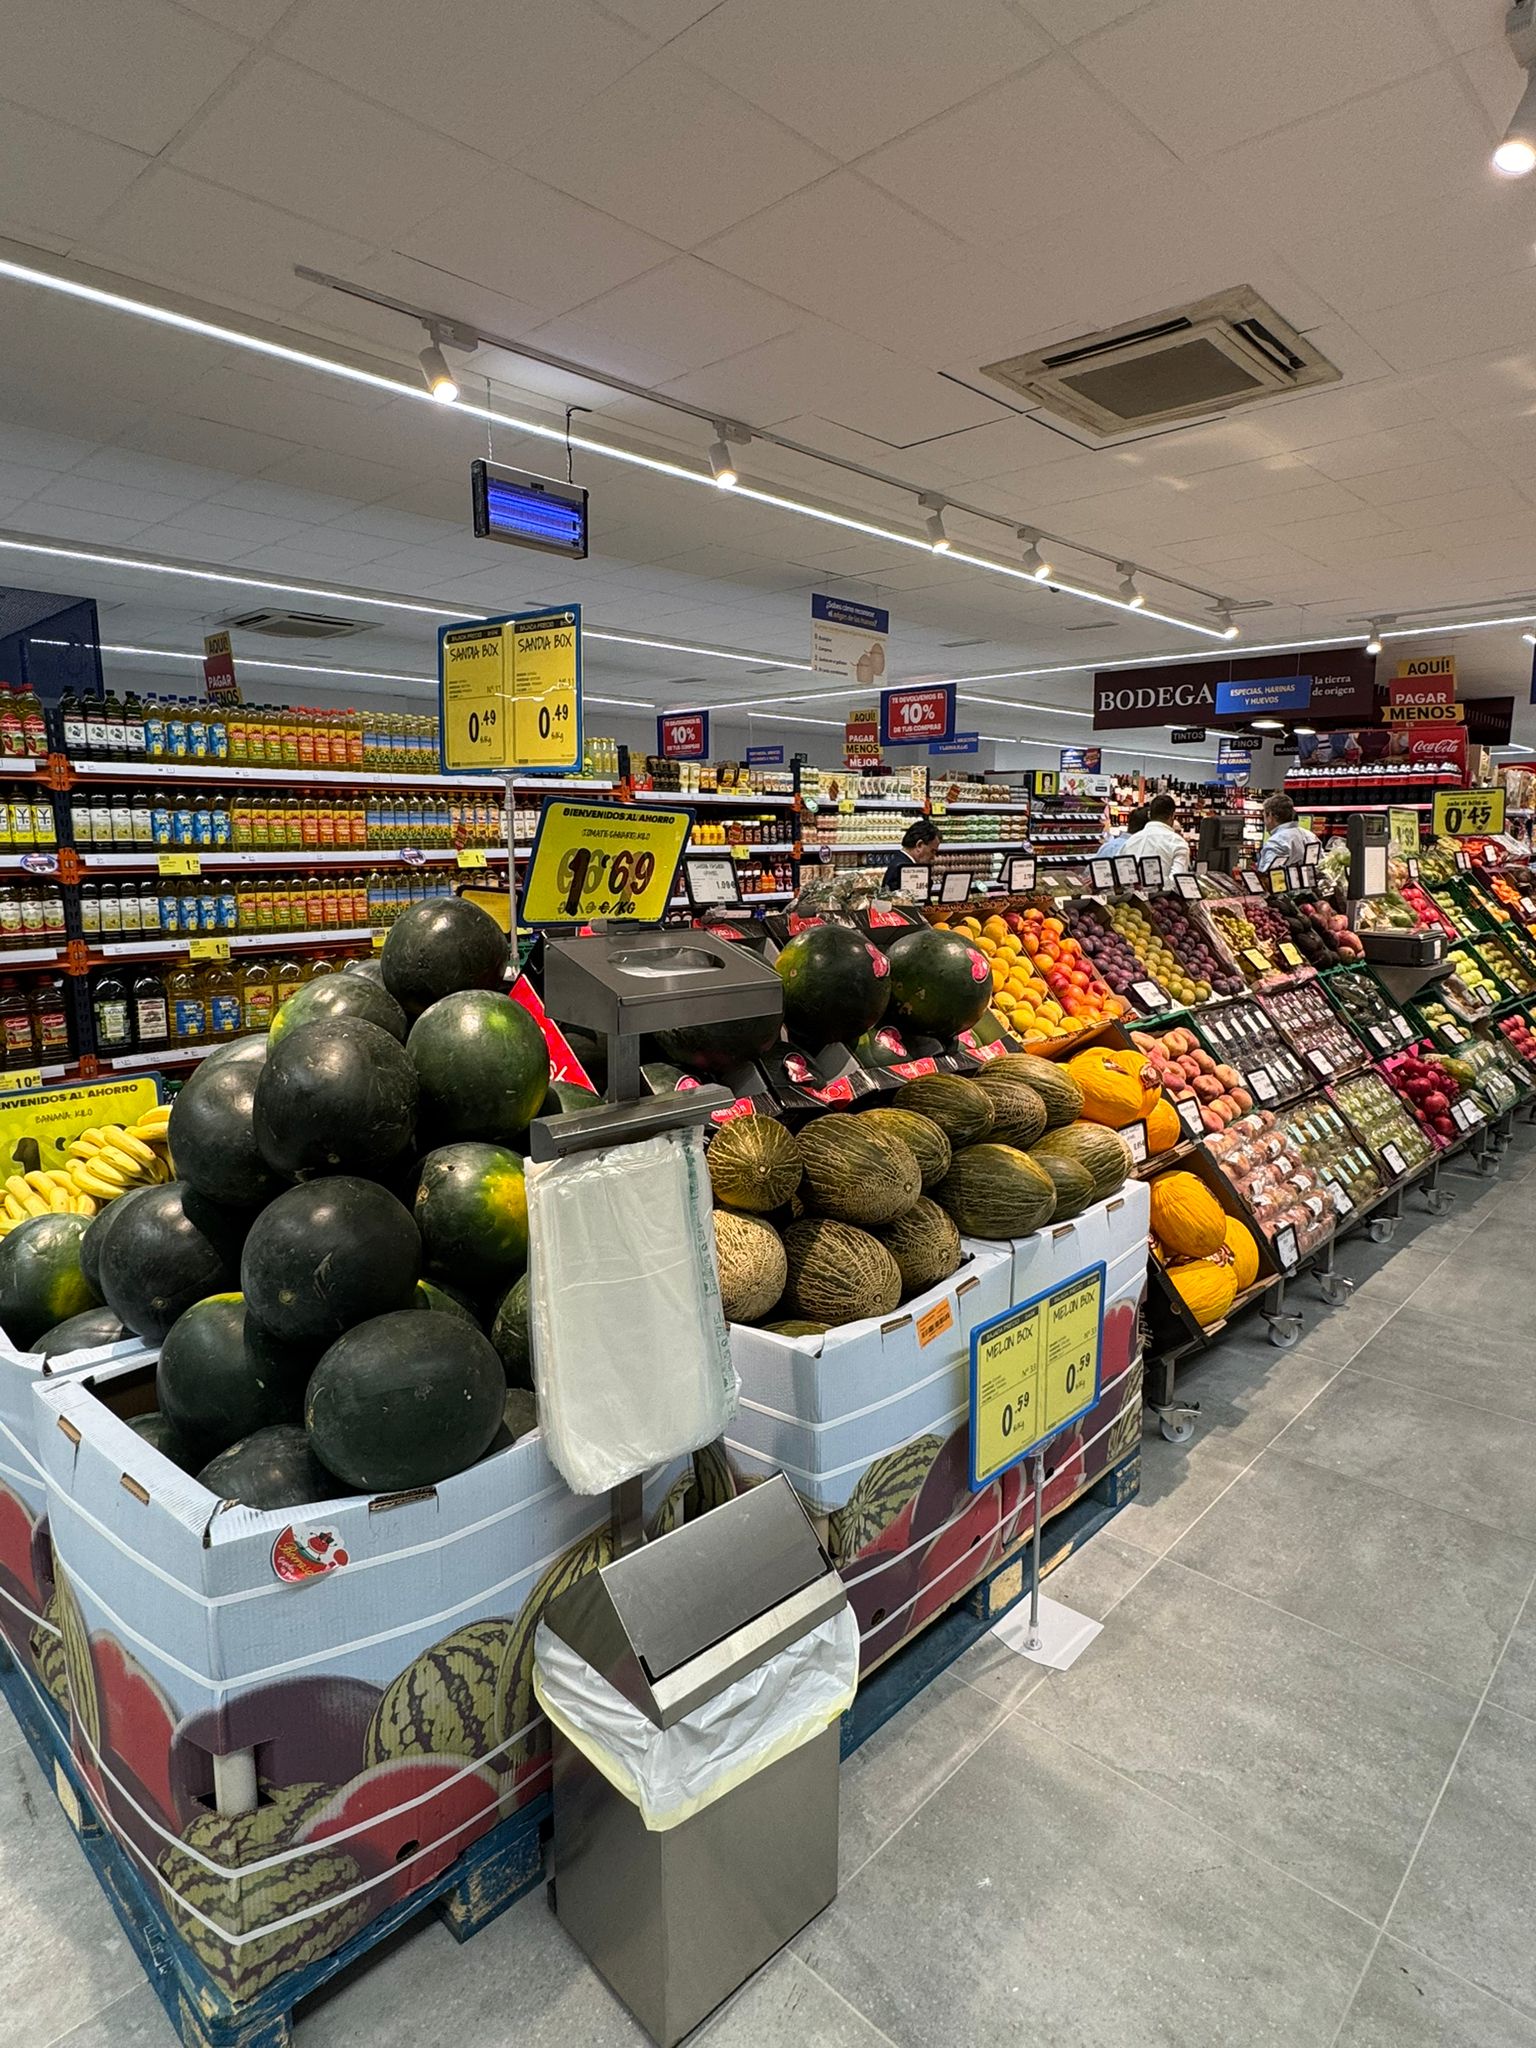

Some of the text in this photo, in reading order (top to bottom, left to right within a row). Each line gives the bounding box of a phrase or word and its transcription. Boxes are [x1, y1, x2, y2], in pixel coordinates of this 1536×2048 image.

[518, 634, 572, 653] SANDIA BOX
[450, 643, 499, 662] SANDIA BOX
[1407, 657, 1450, 676] AQUÍ!
[208, 674, 232, 688] PAGAR
[1324, 674, 1351, 684] tierra
[1099, 684, 1215, 712] BODEGA
[1312, 686, 1355, 697] de origen
[1396, 692, 1447, 704] PAGAR
[900, 703, 935, 725] 10%
[1390, 705, 1456, 720] MENOS
[671, 726, 696, 744] 10%
[849, 735, 874, 743] PAGAR
[1173, 731, 1204, 740] TINTOS
[846, 744, 879, 754] MENOS
[1232, 740, 1259, 748] FINOS
[1412, 739, 1462, 753] Coca-Cola
[849, 758, 879, 767] MEJOR
[563, 807, 675, 825] BIENVENIDOS AL AHORRO
[70, 1090, 85, 1101] AL
[88, 1084, 138, 1098] AHORRO
[1053, 1299, 1080, 1323] MELON
[1082, 1289, 1095, 1308] BOX
[986, 1324, 1034, 1362] MELON BOX
